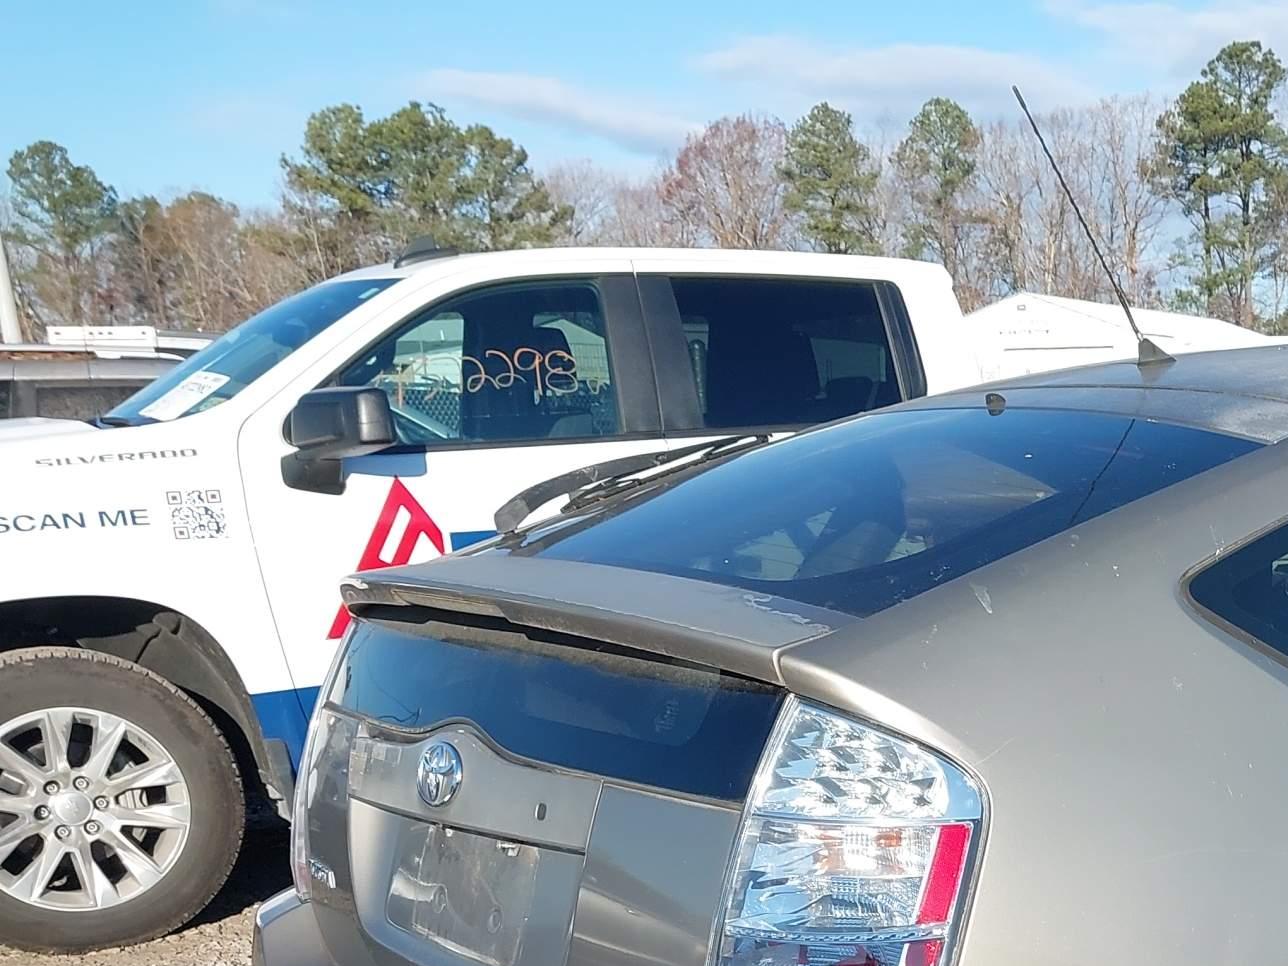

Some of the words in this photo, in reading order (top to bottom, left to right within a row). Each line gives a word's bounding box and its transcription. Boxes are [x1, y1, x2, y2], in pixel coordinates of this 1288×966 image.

[34, 448, 199, 467] SILVERADO
[0, 511, 87, 534] SCAN
[98, 508, 151, 528] ME
